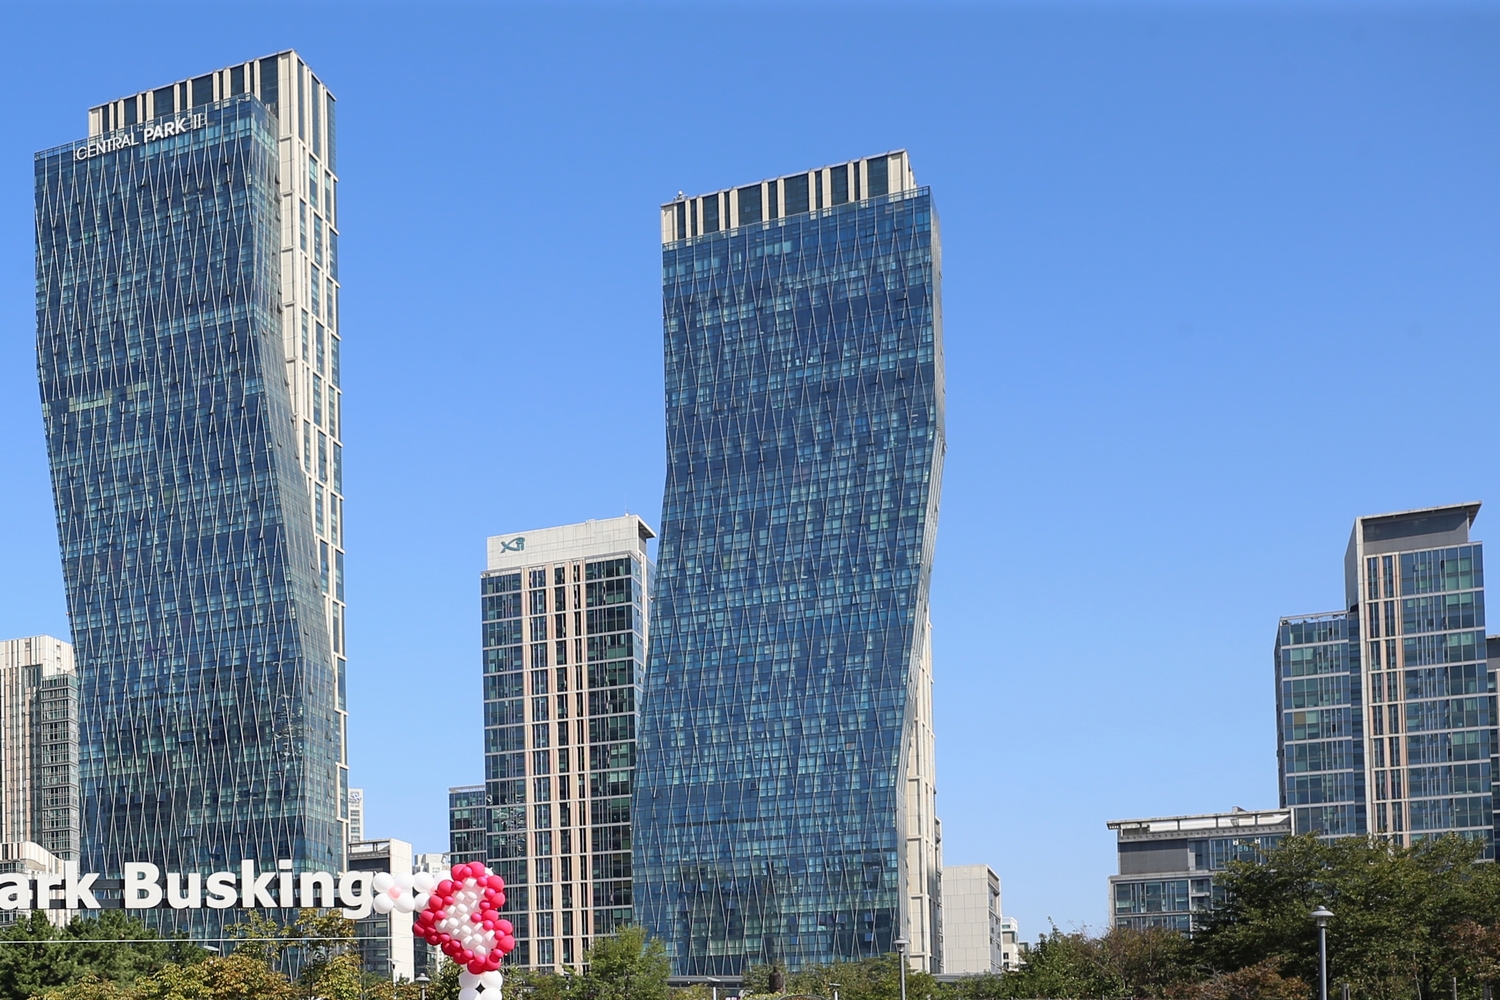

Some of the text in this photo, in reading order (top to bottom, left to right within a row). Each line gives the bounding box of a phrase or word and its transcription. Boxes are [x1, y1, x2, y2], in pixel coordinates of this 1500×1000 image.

[76, 132, 139, 160] CENTRAL
[143, 118, 186, 143] PARK
[124, 859, 374, 920] Busking
